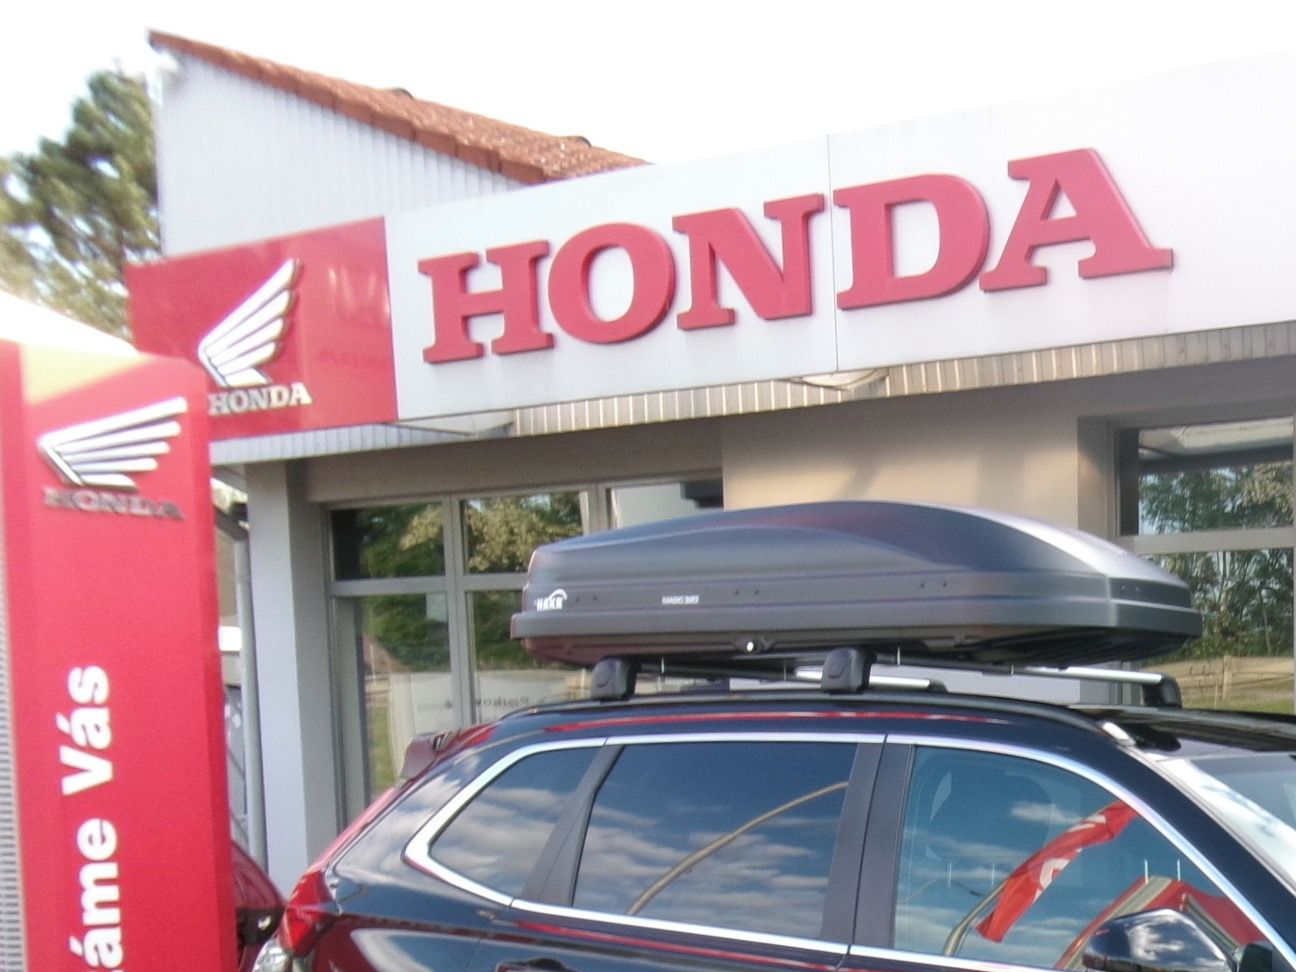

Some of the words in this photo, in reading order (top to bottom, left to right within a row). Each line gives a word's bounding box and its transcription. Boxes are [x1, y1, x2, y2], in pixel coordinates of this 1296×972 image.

[417, 148, 1174, 364] HONDA
[208, 382, 313, 416] HONDA
[43, 486, 185, 521] HONDA
[55, 665, 114, 796] Vás
